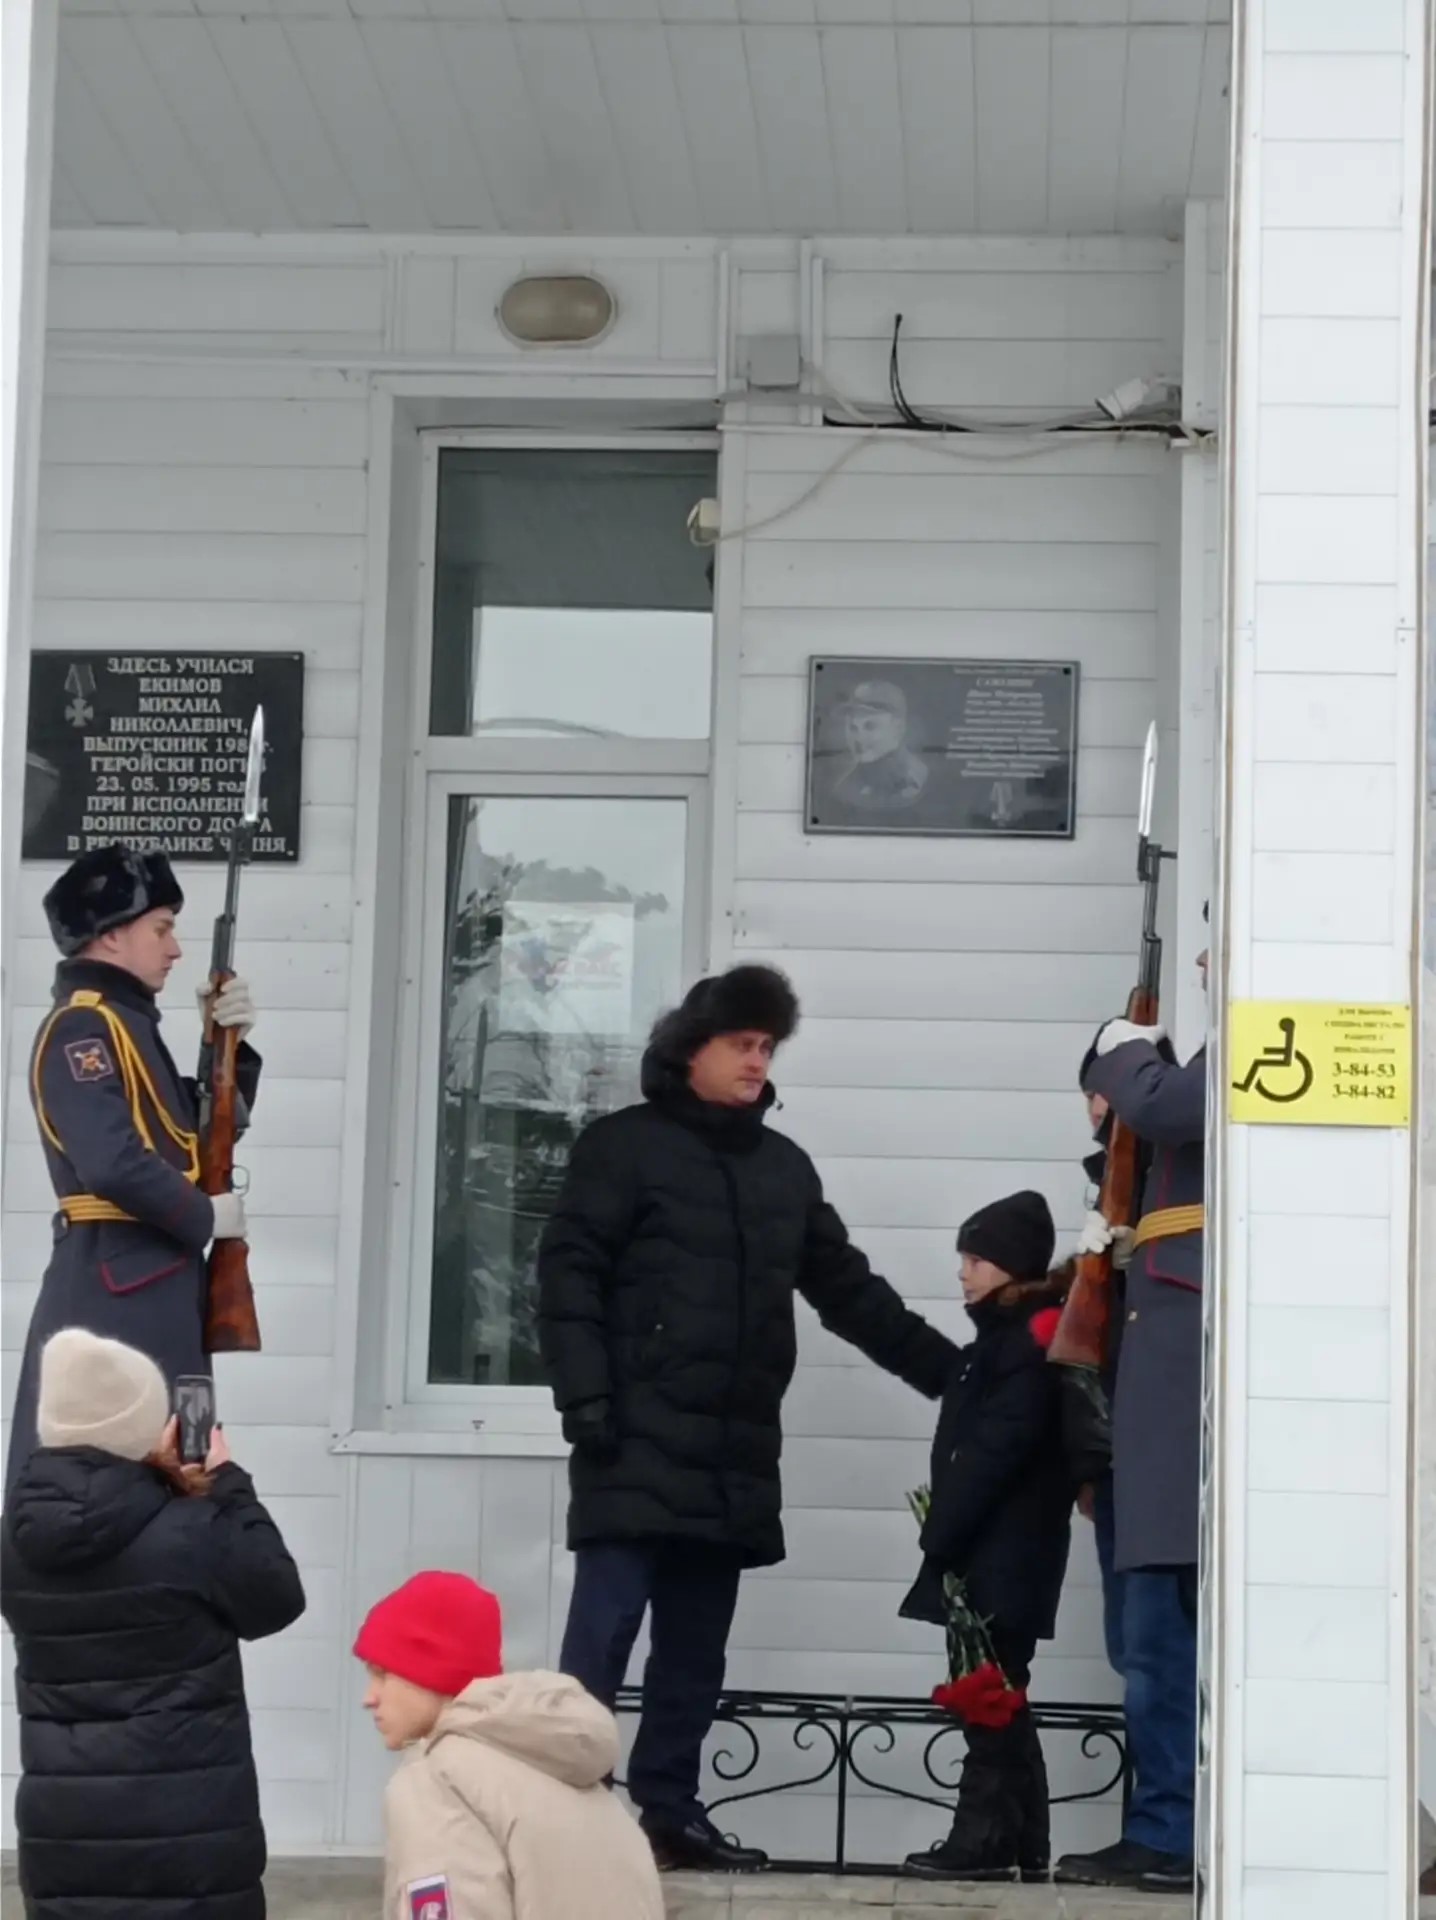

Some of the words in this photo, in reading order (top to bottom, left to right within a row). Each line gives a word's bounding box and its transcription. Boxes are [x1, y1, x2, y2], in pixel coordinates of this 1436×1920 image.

[107, 657, 171, 674] ЗДЕСЬ
[176, 658, 254, 674] УЧИЛСЯ
[139, 677, 222, 693] ЕКИМОВ
[138, 697, 222, 713] МИХАИЛ
[110, 717, 249, 736] НИКОЛАЕВИЧ,
[83, 736, 208, 752] ВЫПУСКНИК
[215, 737, 257, 753] 198
[91, 752, 195, 773] ГЕРОЙСКИ
[96, 776, 125, 793] 23.
[131, 776, 160, 793] 05.
[167, 776, 211, 793] 1995
[217, 781, 254, 793] год
[87, 796, 126, 812] ПРИ
[82, 815, 202, 832] ВОИНСКОГО
[206, 816, 273, 833] ДОА
[67, 836, 80, 851] В
[219, 837, 286, 853] ЧНЯ
[1332, 1062, 1396, 1078] 3-84-53
[1332, 1083, 1396, 1099] 3-84-82
